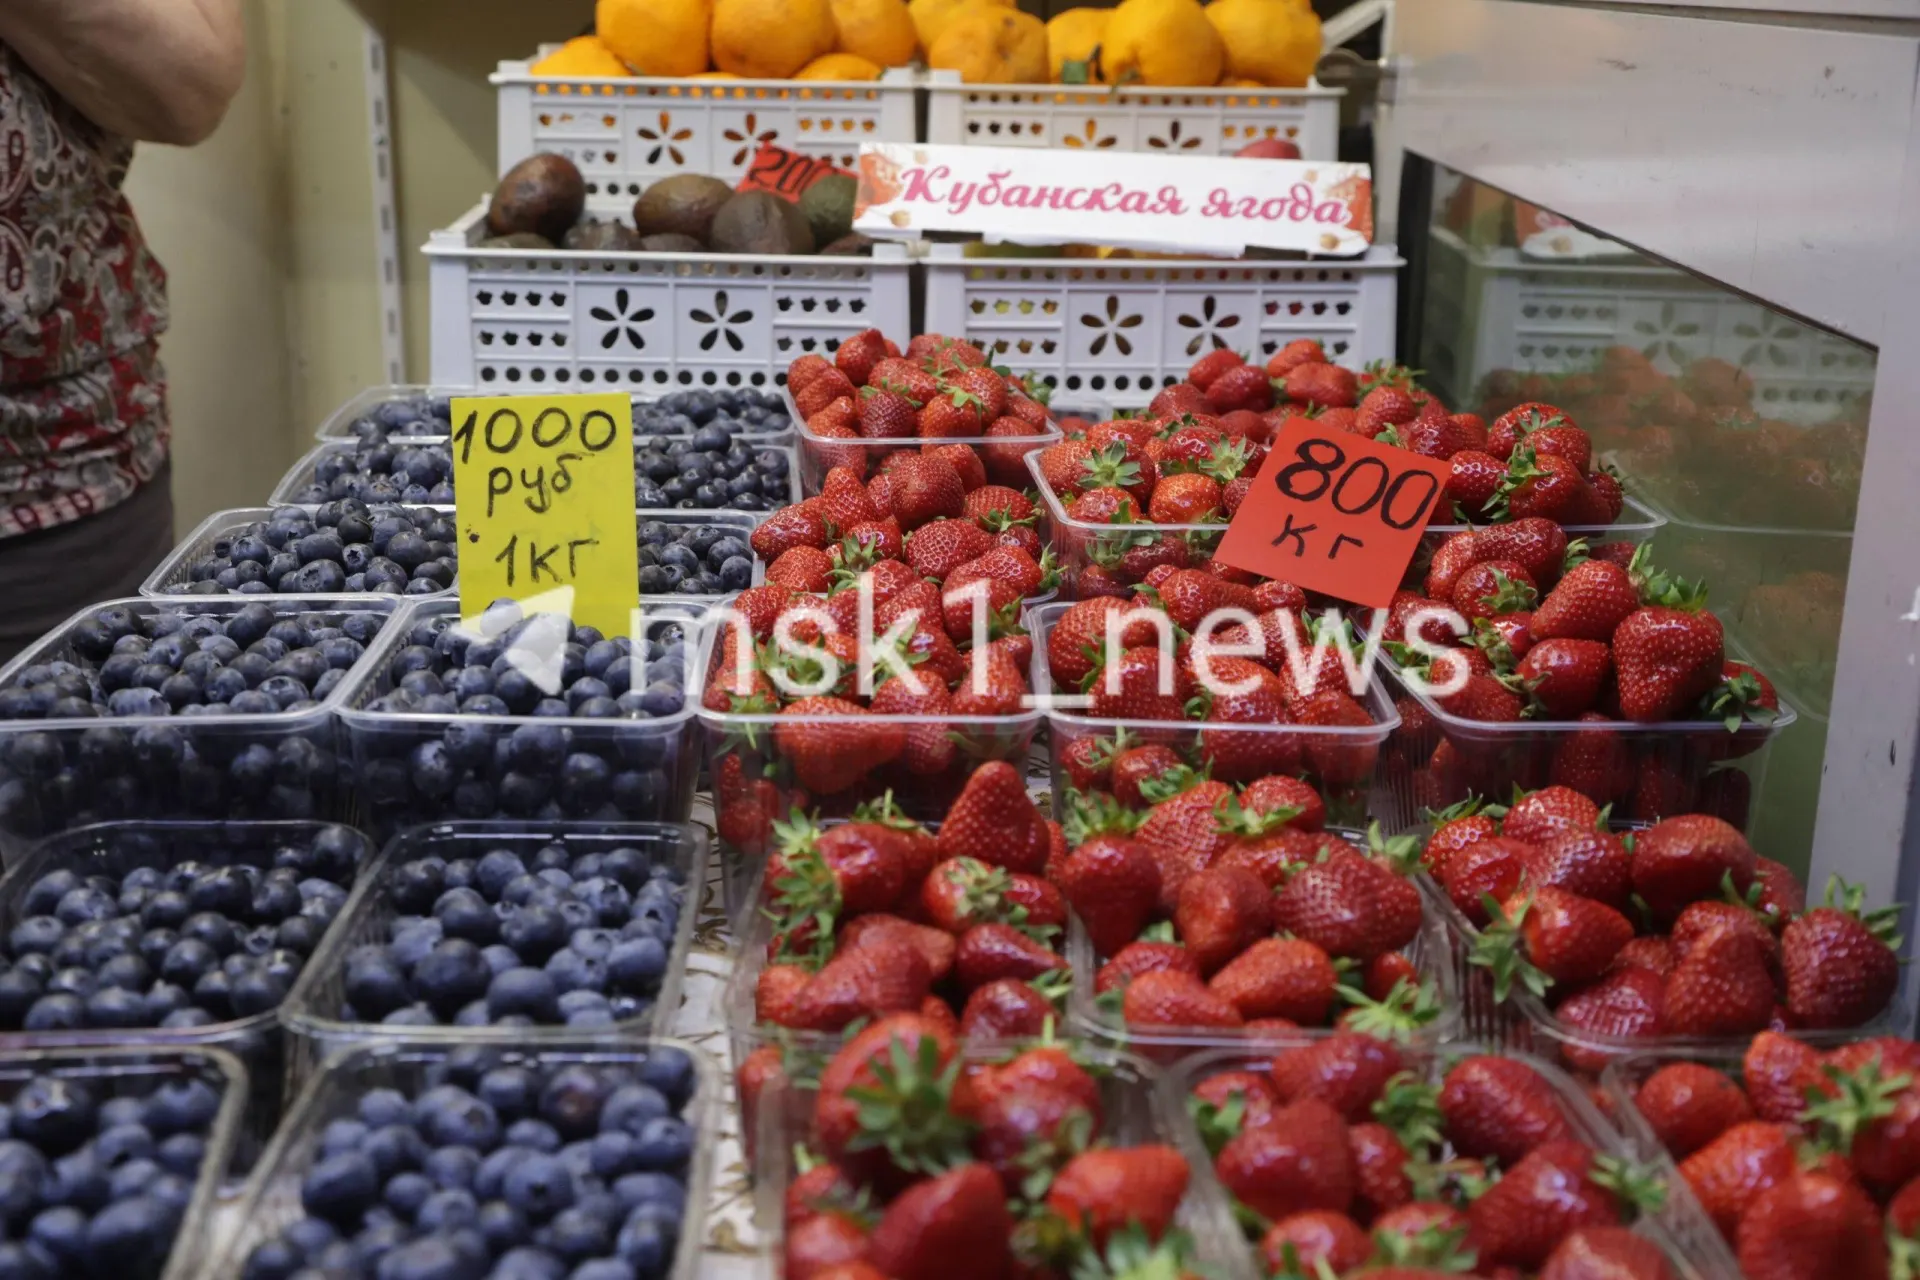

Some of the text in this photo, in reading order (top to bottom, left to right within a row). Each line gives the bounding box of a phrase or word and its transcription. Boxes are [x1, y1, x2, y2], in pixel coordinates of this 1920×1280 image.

[901, 165, 1348, 223] Кубанская ягода
[453, 406, 617, 464] 1000
[486, 453, 592, 518] руб
[1275, 438, 1438, 530] 800
